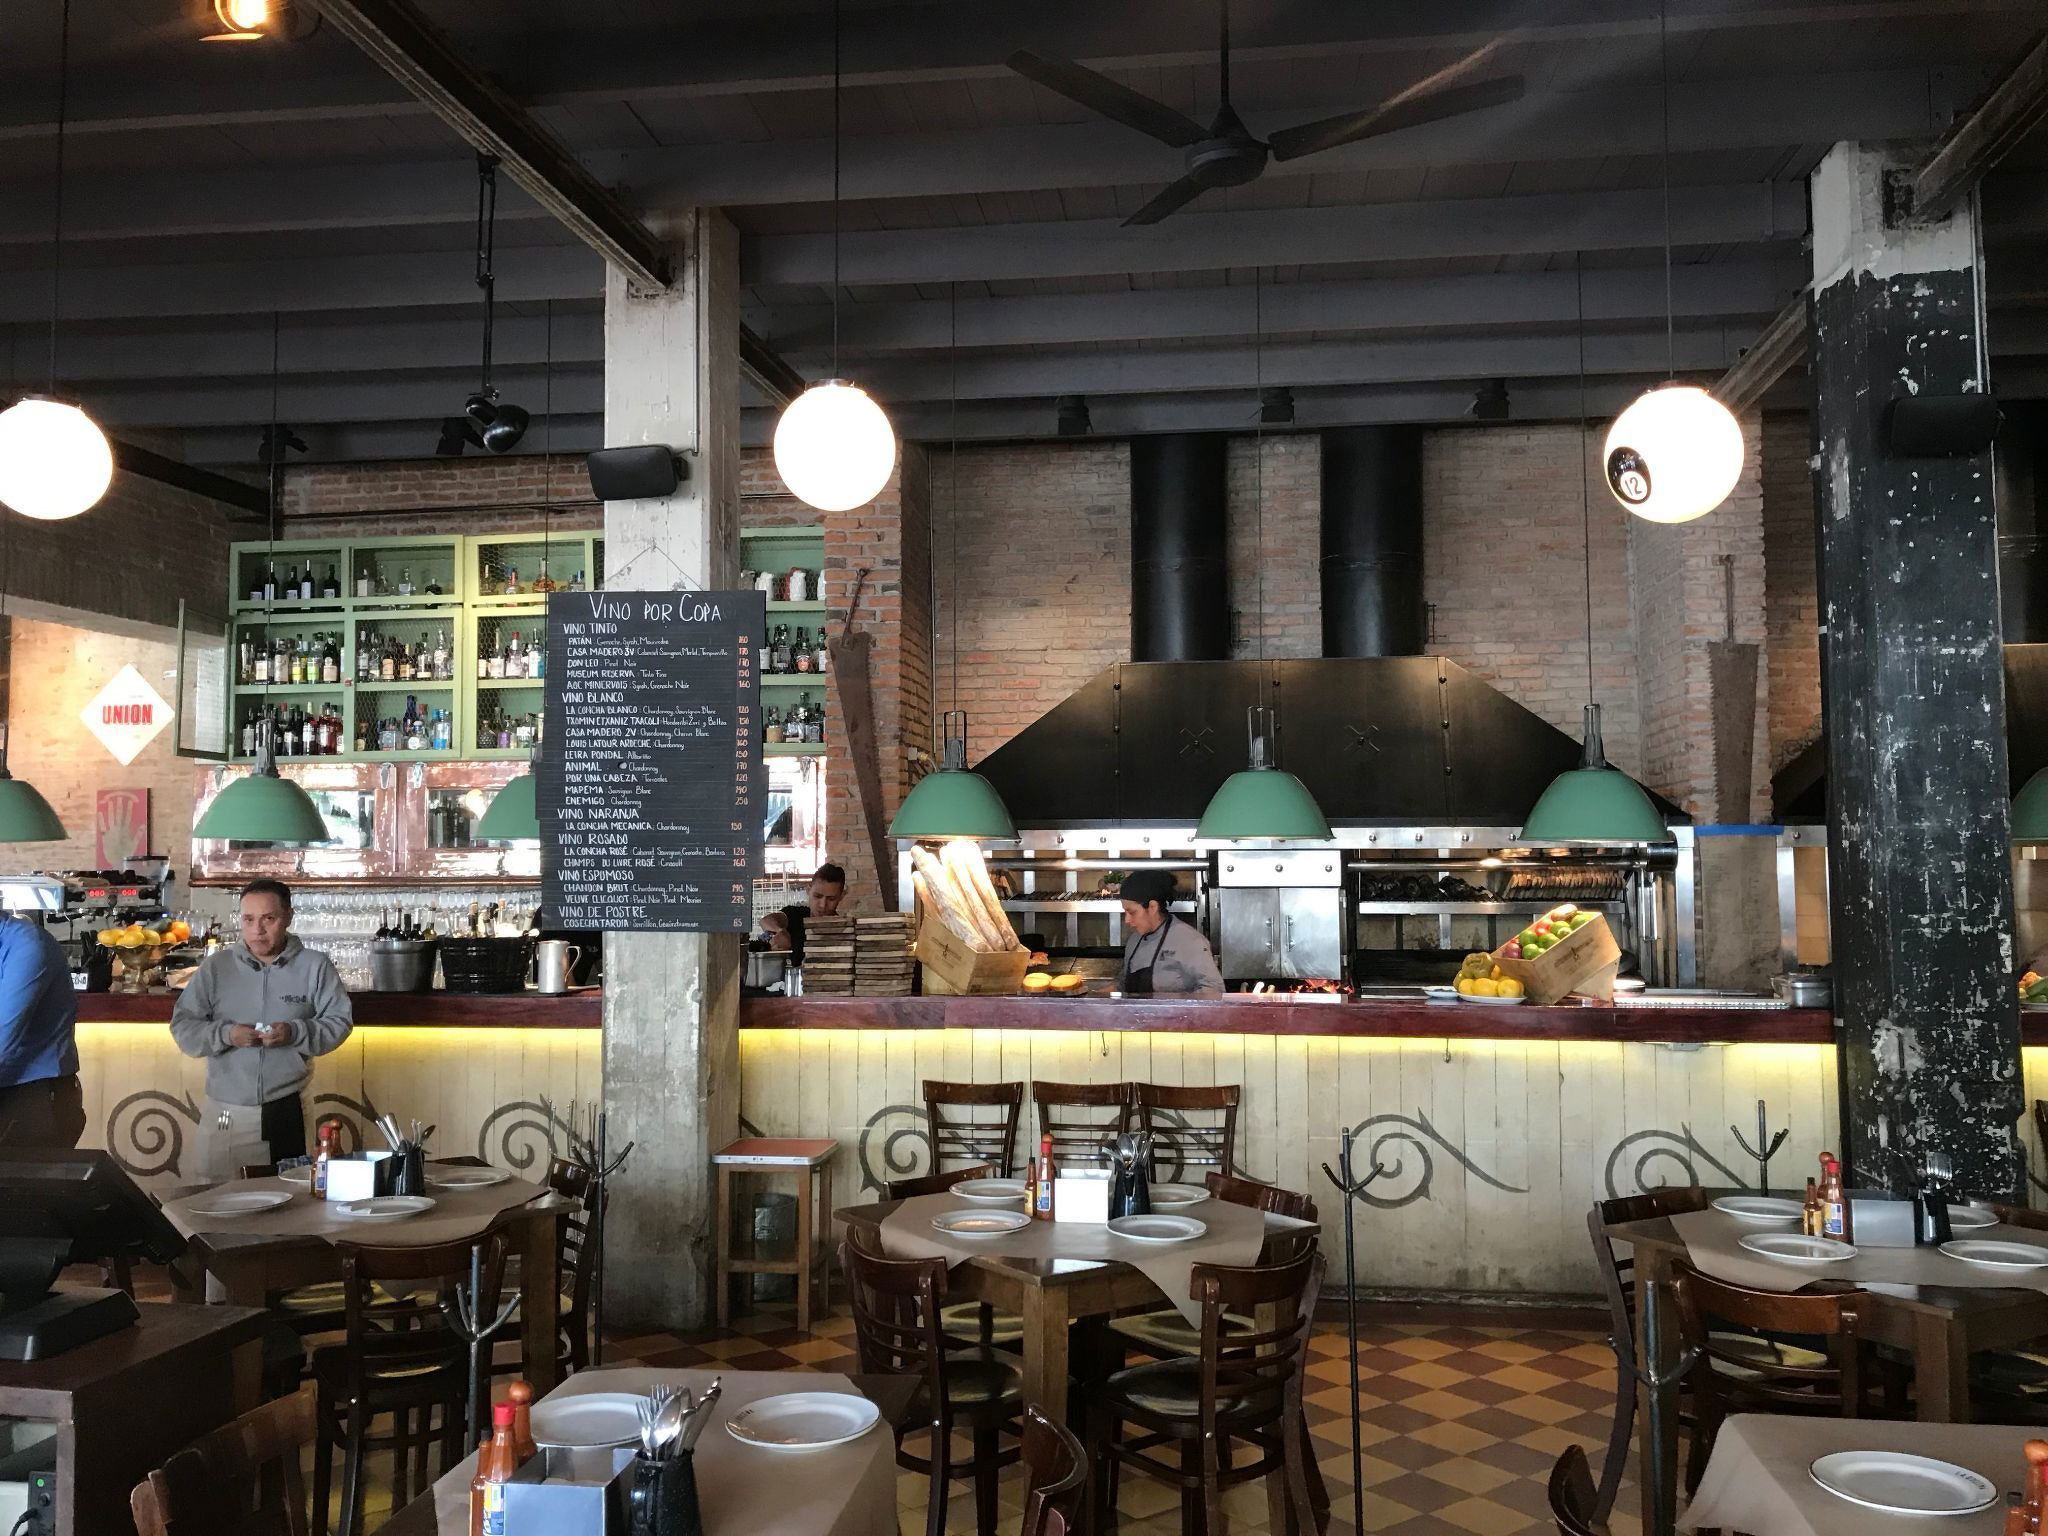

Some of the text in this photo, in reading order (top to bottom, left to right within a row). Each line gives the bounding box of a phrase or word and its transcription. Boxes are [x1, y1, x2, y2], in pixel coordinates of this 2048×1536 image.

[1624, 476, 1643, 497] 12
[563, 623, 617, 634] VINO TINTO
[567, 647, 587, 656] CASA
[589, 647, 623, 656] MADERO
[624, 647, 635, 656] 3V
[567, 659, 583, 668] DON
[585, 659, 599, 668] LEO
[567, 669, 599, 678] MUSEUM
[601, 669, 635, 678] RESERVA
[562, 692, 624, 703] VINO BLANCO
[102, 704, 153, 725] UNION
[566, 706, 575, 714] LA
[578, 706, 605, 714] CONCHA
[607, 706, 638, 714] BLANCO
[566, 728, 585, 736] CASA
[587, 728, 622, 736] MADERO
[625, 728, 636, 736] 2V
[566, 739, 587, 747] LOUIS
[589, 739, 618, 747] LATOUR
[565, 762, 602, 771] ANIMAL
[566, 774, 582, 782] POR
[584, 774, 601, 782] UNA
[603, 774, 638, 782] CABEZA
[565, 786, 603, 794] MAPEMA
[565, 797, 605, 805] ENEMIGO
[557, 808, 639, 819] VINO NARANJA
[566, 822, 575, 830] LA
[577, 822, 608, 830] CONCHA
[558, 834, 628, 844] VINO ROSADO
[564, 847, 575, 855] LA
[576, 847, 607, 855] CONCHA
[558, 870, 634, 881] VINO ESPUMOSO
[563, 884, 603, 892] CHANDON
[607, 884, 629, 892] BRUT
[565, 895, 589, 903] VEUVE
[558, 906, 647, 918] VINO DE POSTRE
